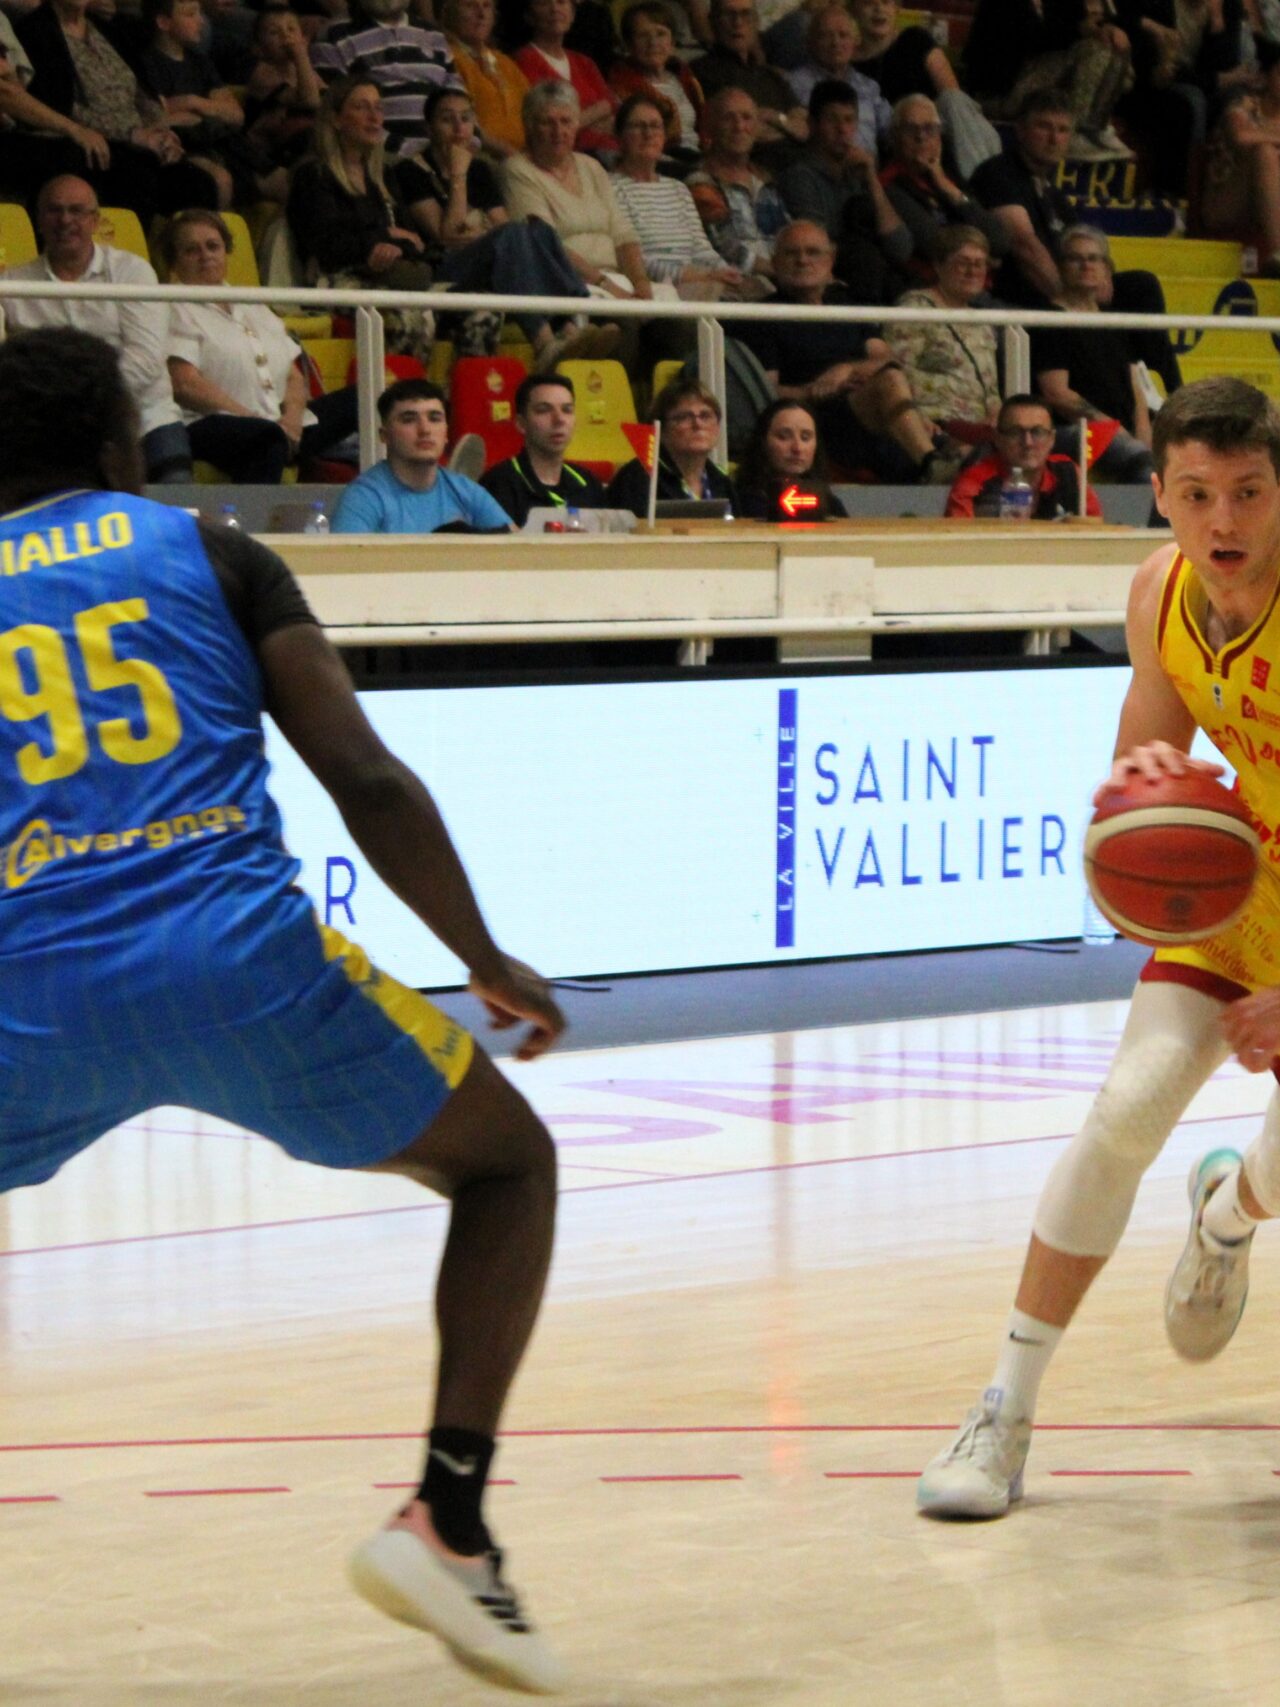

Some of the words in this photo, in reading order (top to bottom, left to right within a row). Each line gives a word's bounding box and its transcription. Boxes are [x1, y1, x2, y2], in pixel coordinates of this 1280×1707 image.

[0, 512, 133, 576] IALLO
[0, 598, 182, 785] 95
[777, 726, 795, 840] VILLE
[814, 735, 995, 806] SAINT
[815, 814, 1067, 889] VALLIER
[777, 868, 794, 912] LA
